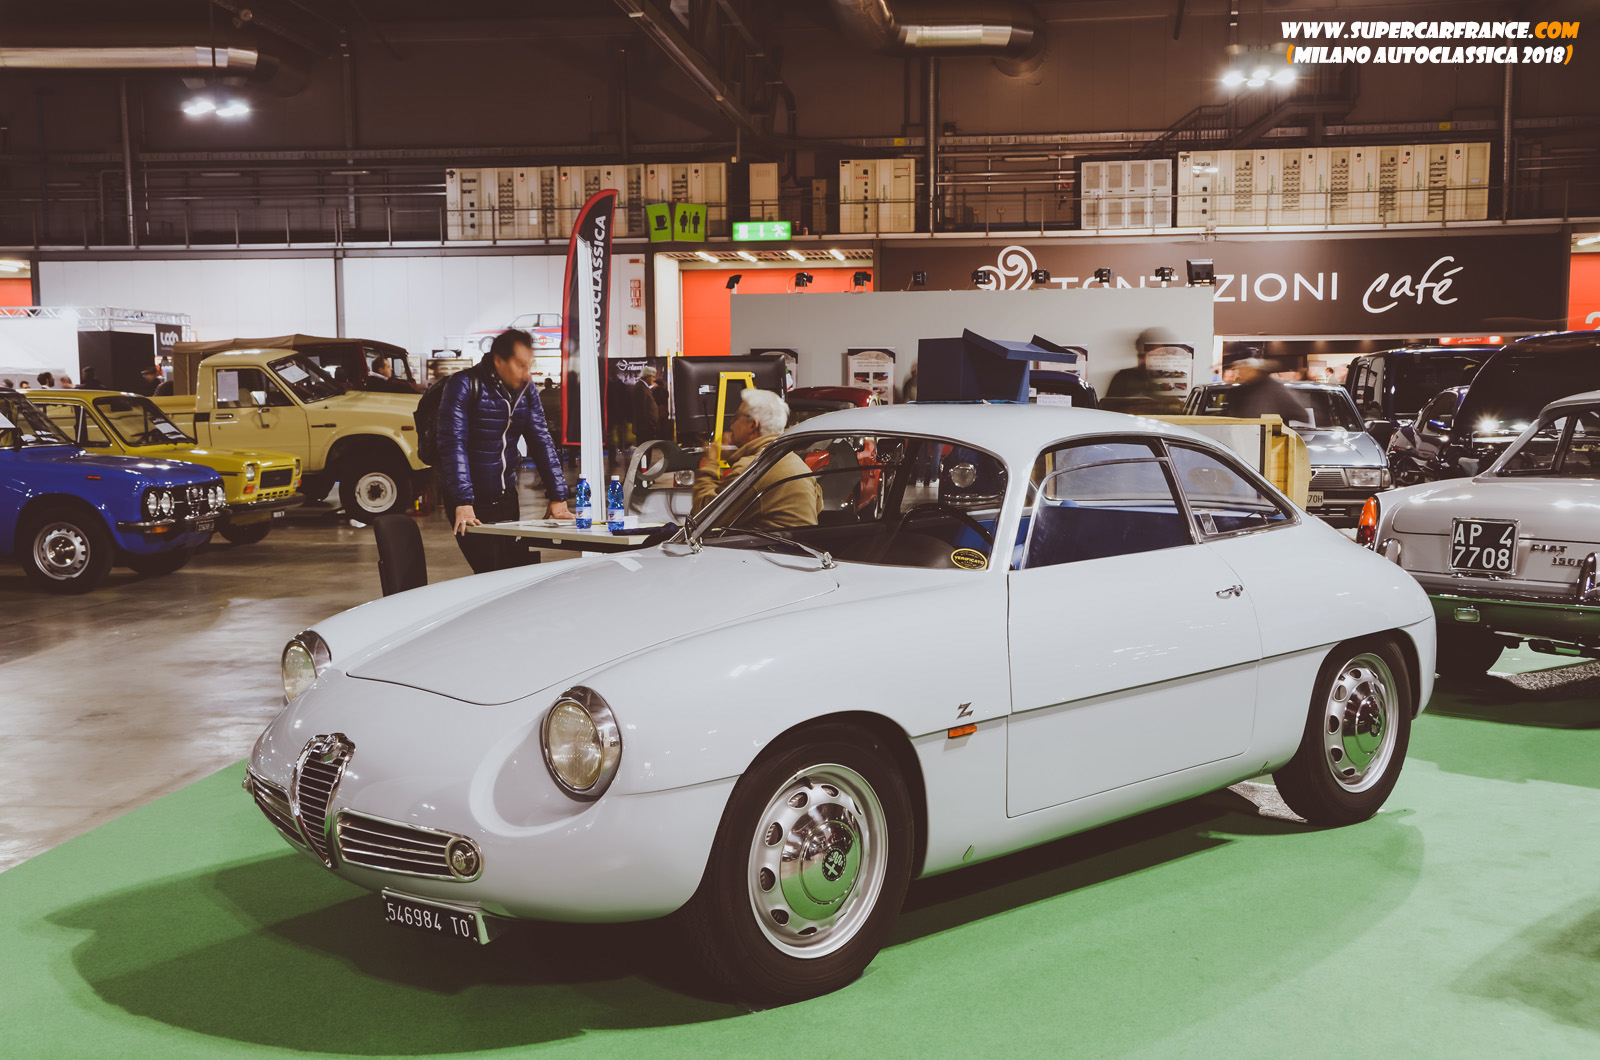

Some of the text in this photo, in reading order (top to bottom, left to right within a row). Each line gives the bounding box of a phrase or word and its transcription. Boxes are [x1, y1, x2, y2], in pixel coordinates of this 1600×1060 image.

[1362, 256, 1463, 313] café
[1307, 494, 1323, 504] 70H
[1454, 523, 1513, 548] AP 4
[1453, 546, 1510, 570] 7708
[1530, 544, 1568, 553] FIAT
[387, 902, 470, 937] 546984 TO
